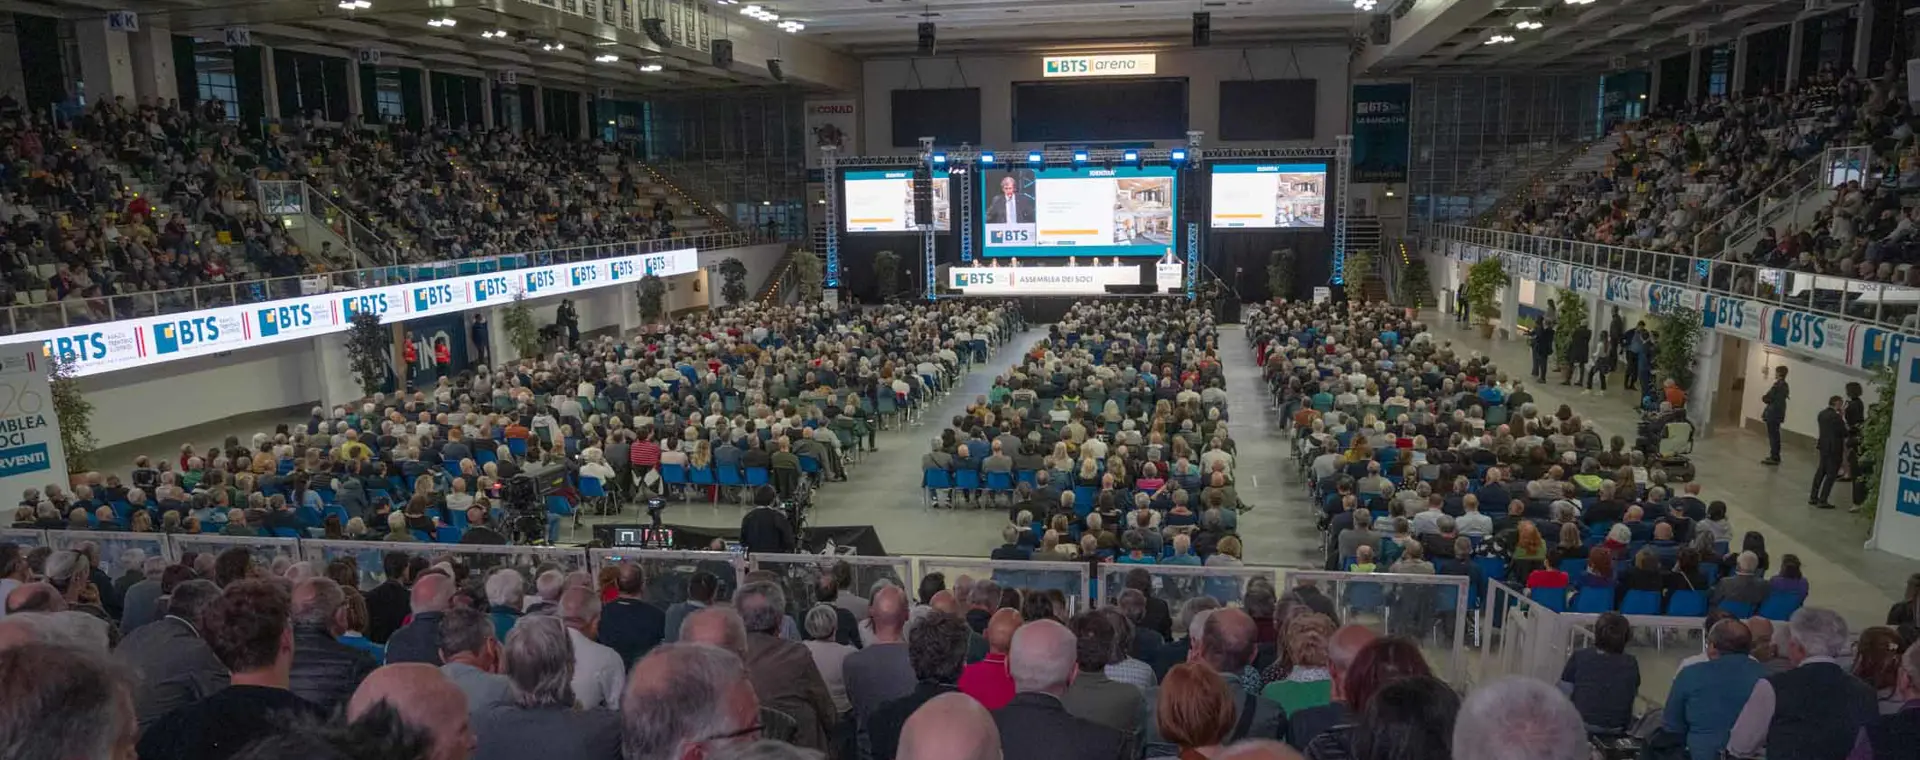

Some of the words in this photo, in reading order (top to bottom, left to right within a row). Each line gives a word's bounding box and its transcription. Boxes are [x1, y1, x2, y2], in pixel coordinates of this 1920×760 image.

[124, 14, 136, 28] K
[1061, 60, 1088, 72] BTS
[1095, 59, 1136, 70] arena
[817, 105, 854, 114] CONAD
[1005, 230, 1028, 241] BTS
[619, 260, 633, 275] BTS
[652, 256, 665, 270] BTS
[537, 269, 555, 287] BTS
[581, 265, 597, 282] BTS
[970, 272, 994, 284] BTS
[1020, 276, 1060, 284] ASSEMBLEA
[429, 284, 452, 305] BTS
[487, 277, 508, 296] BTS
[359, 293, 388, 314] BTS
[1719, 297, 1746, 328] BTS
[279, 303, 312, 330] BTS
[179, 316, 219, 345] BTS
[1790, 311, 1828, 349] BTS
[57, 332, 107, 364] BTS
